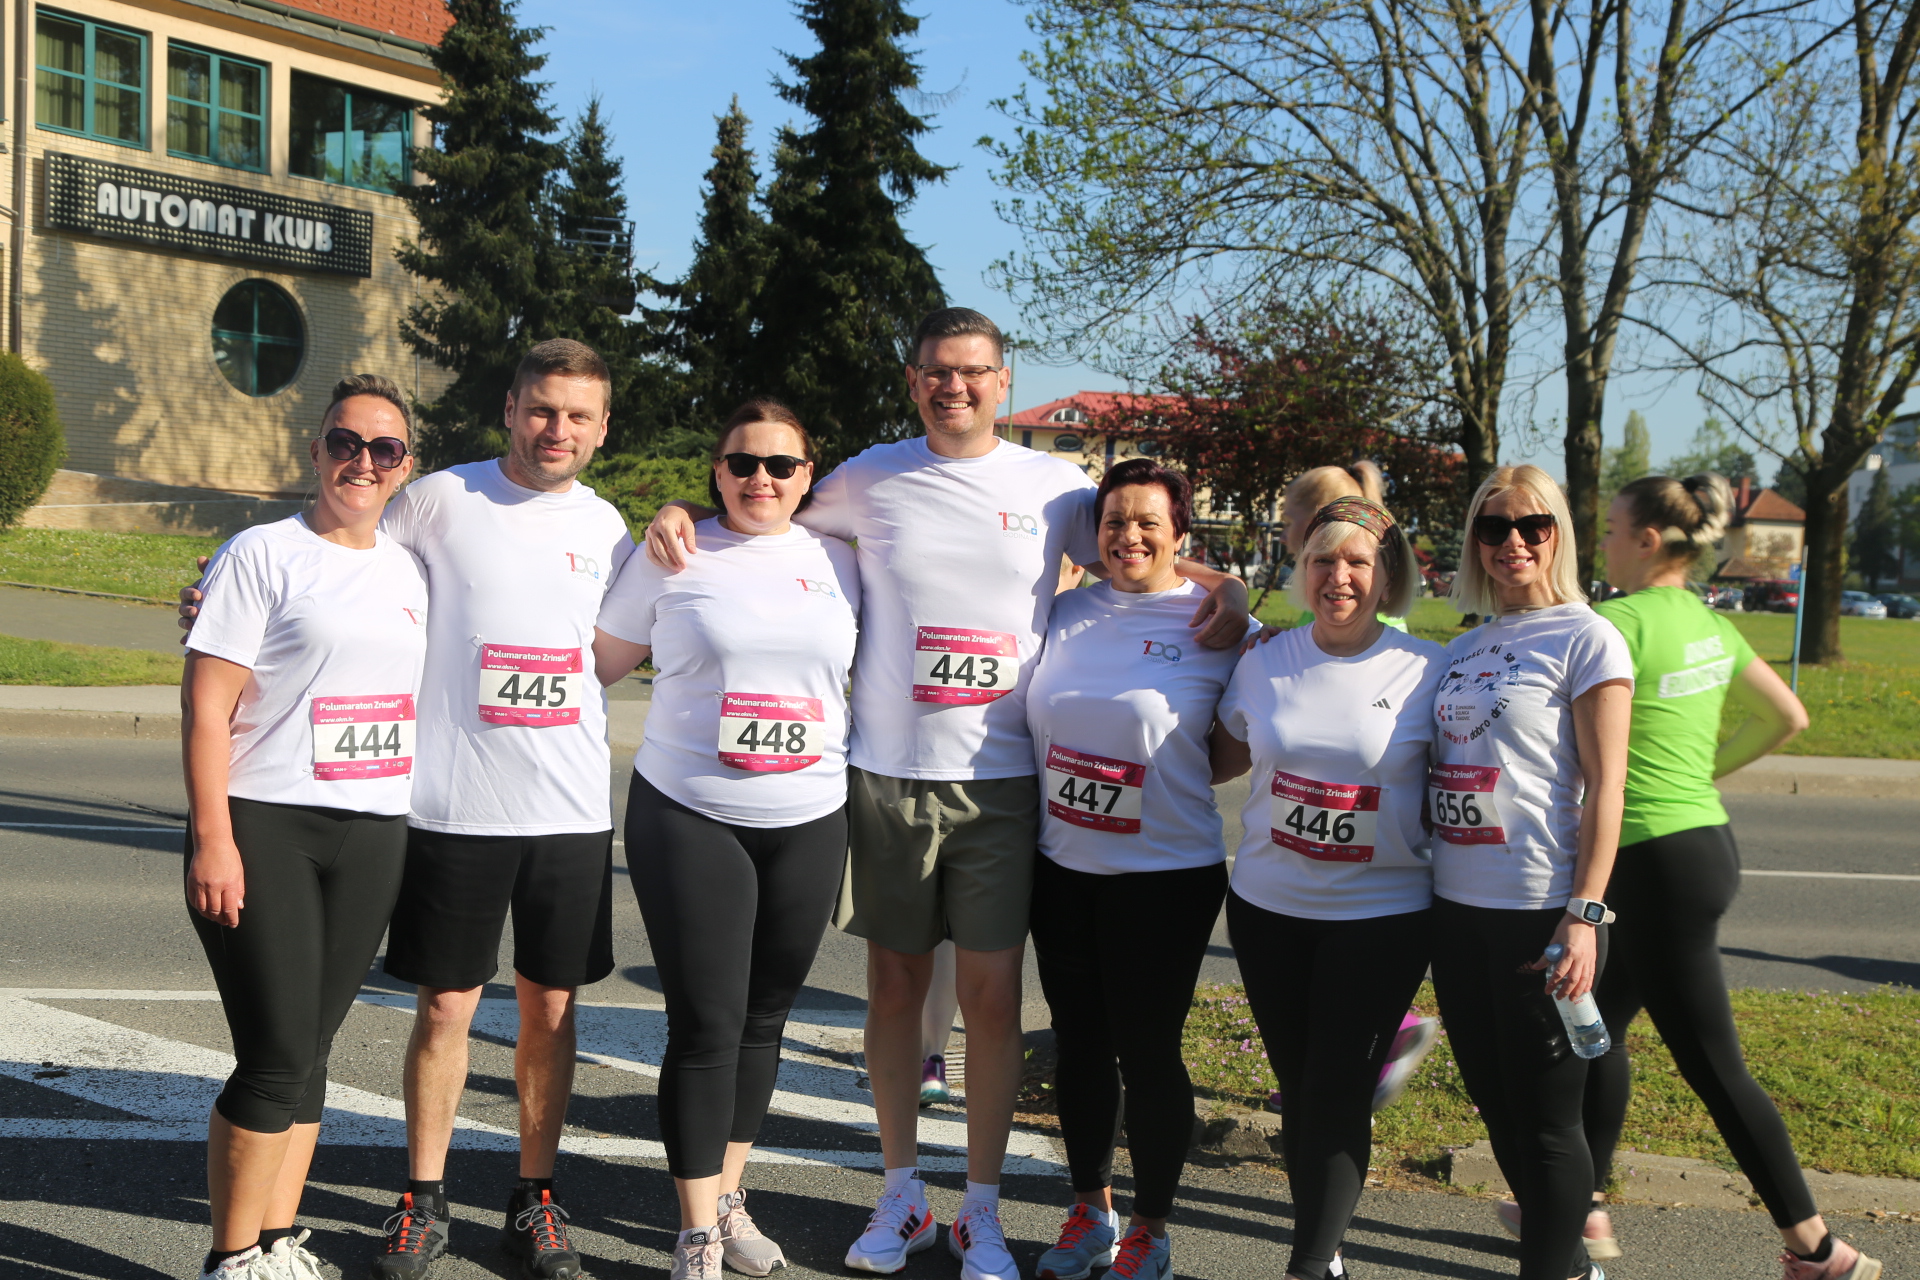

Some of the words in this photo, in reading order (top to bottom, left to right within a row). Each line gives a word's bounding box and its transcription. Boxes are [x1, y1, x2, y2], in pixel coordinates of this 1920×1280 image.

[97, 182, 256, 239] AUTOMAT
[264, 212, 333, 252] KLUB
[921, 631, 970, 642] Polumaraton
[488, 649, 540, 661] Polumaraton
[930, 654, 999, 688] 443
[320, 701, 373, 711] Polumaraton
[498, 674, 566, 707] 445
[727, 697, 778, 708] Polumaraton
[1470, 720, 1491, 741] dobro
[1491, 697, 1510, 719] drži
[335, 723, 401, 758] 444
[737, 721, 806, 753] 448
[1051, 751, 1093, 768] Polumaraton
[1059, 777, 1122, 814] 447
[1277, 777, 1325, 795] Polumaraton
[1326, 788, 1355, 799] Zrinski
[1285, 804, 1355, 843] 446
[1437, 791, 1482, 826] 656
